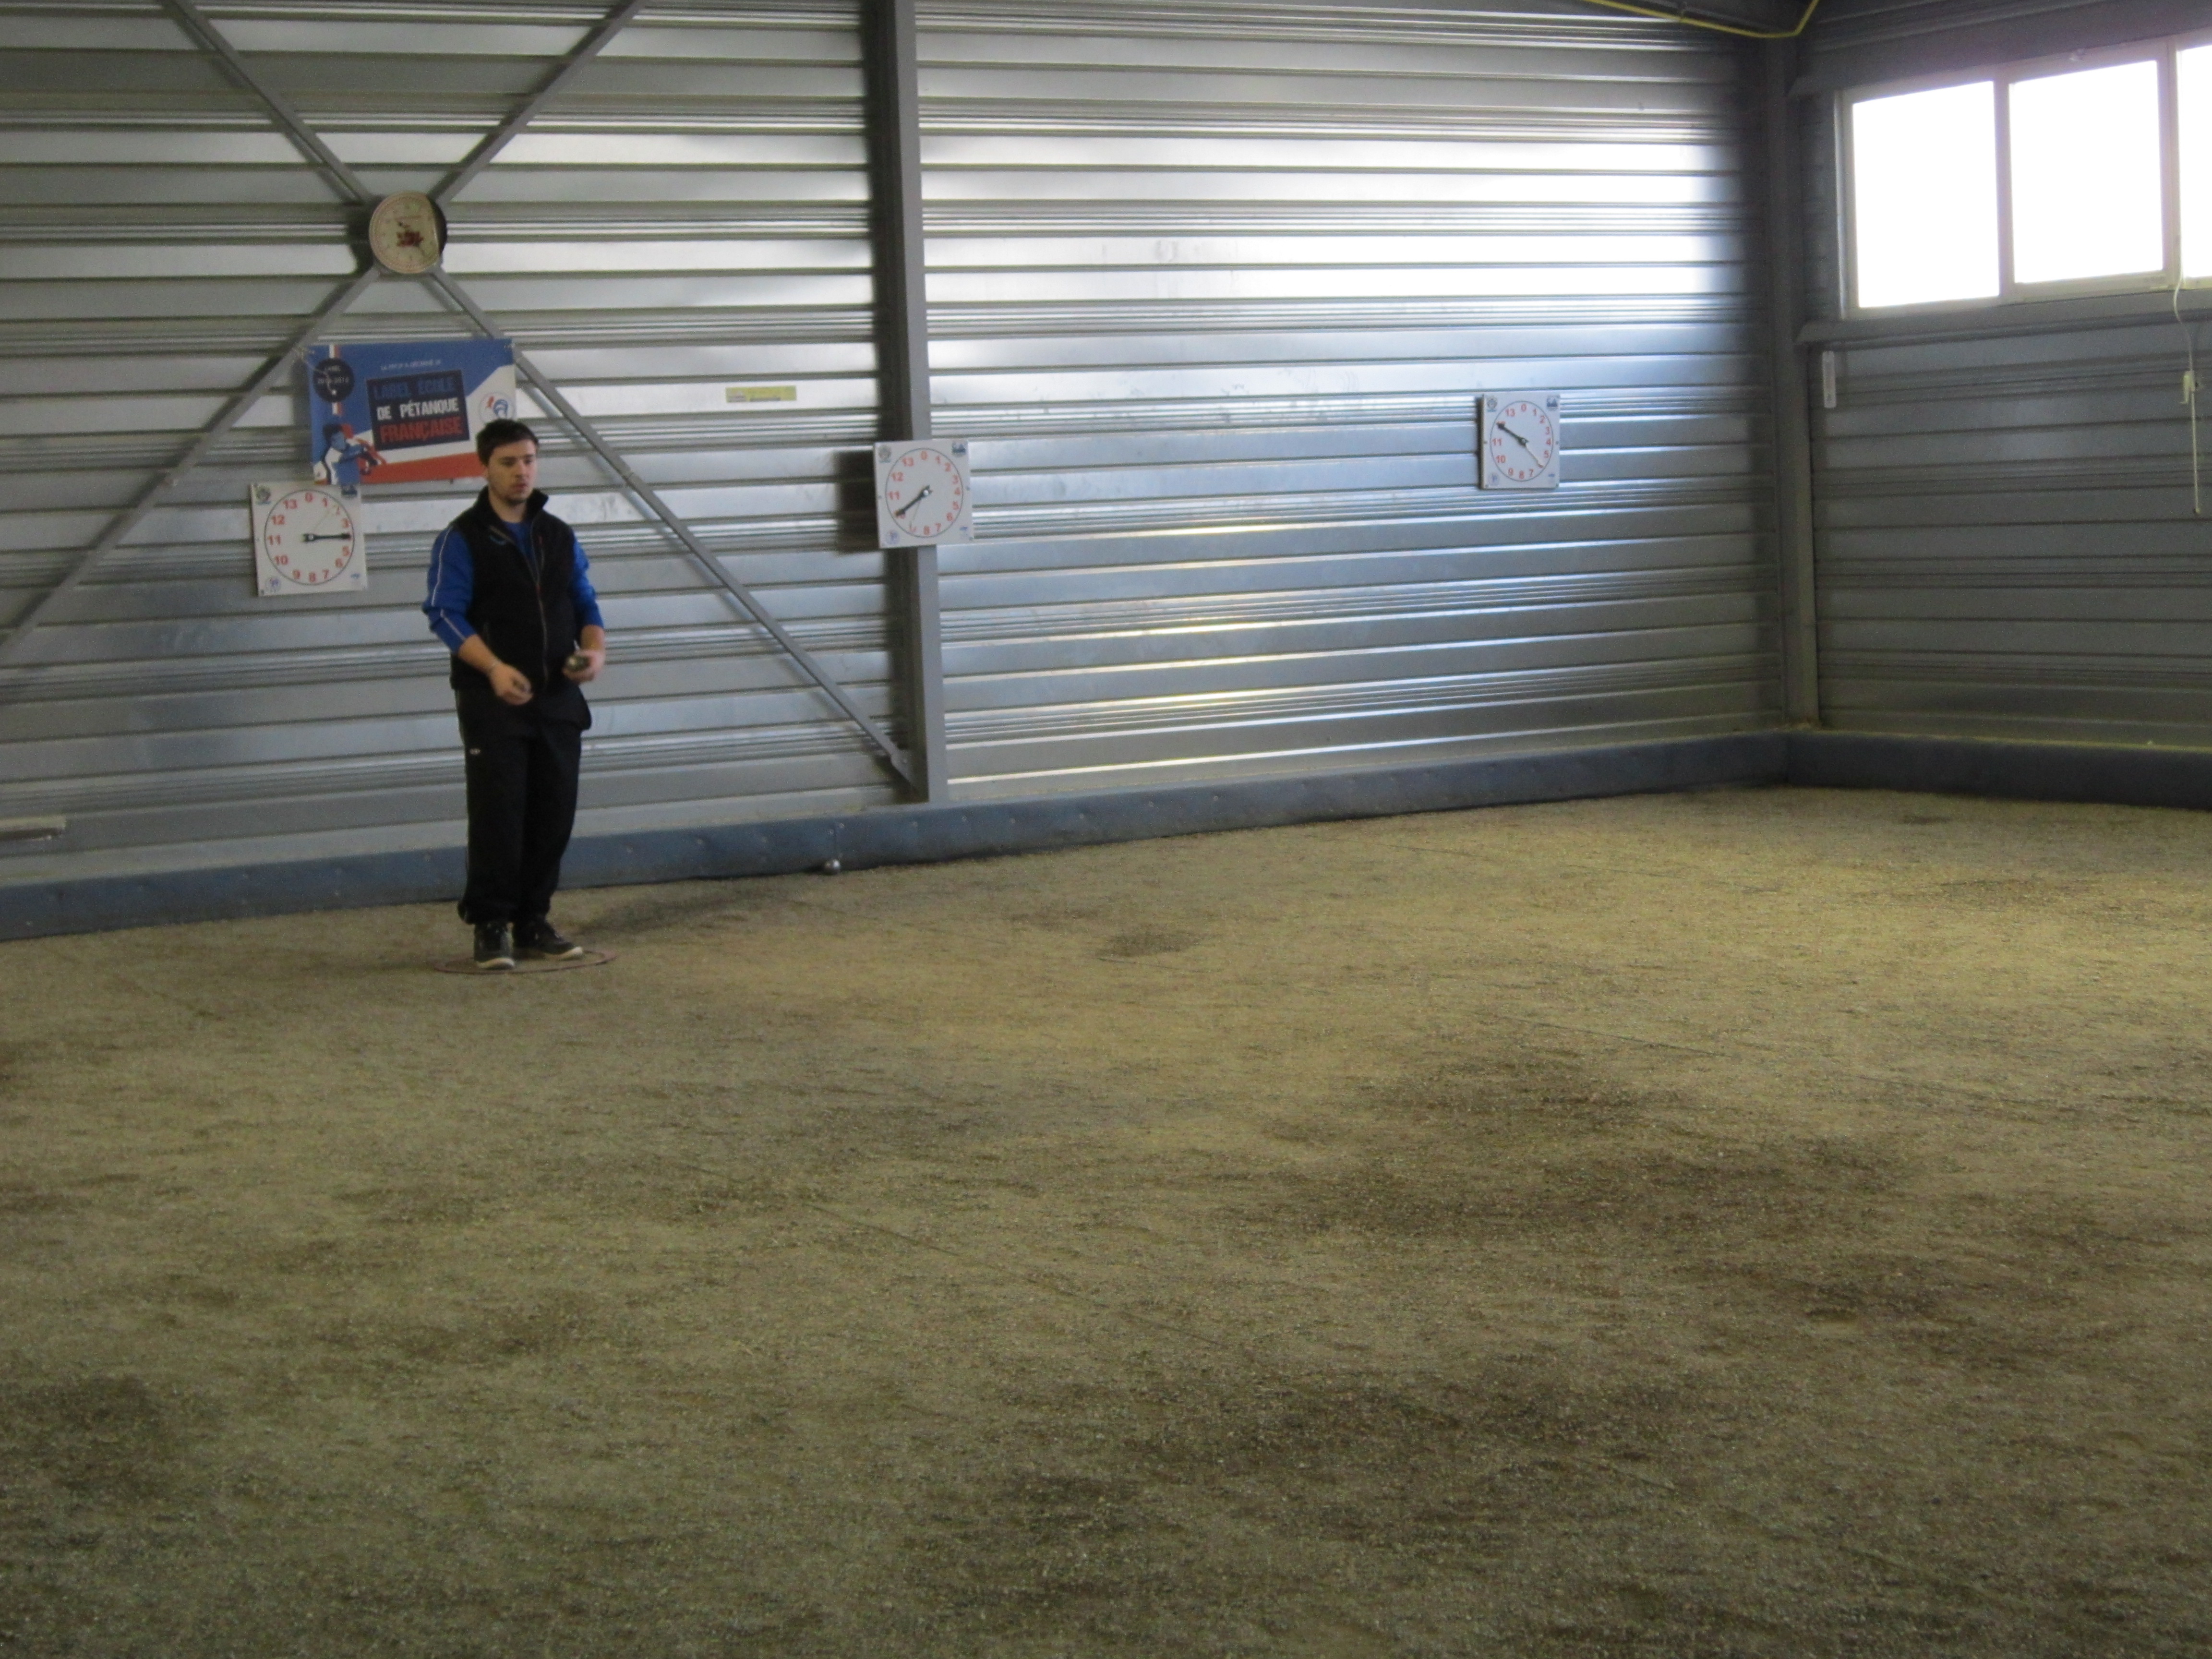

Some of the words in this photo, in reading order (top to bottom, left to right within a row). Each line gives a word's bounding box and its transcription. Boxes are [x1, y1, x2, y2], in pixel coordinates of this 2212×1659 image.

[376, 406, 392, 421] DE
[400, 398, 459, 418] PÉTANQUE
[380, 416, 463, 443] FRANÇAISE
[1496, 455, 1506, 464] 10
